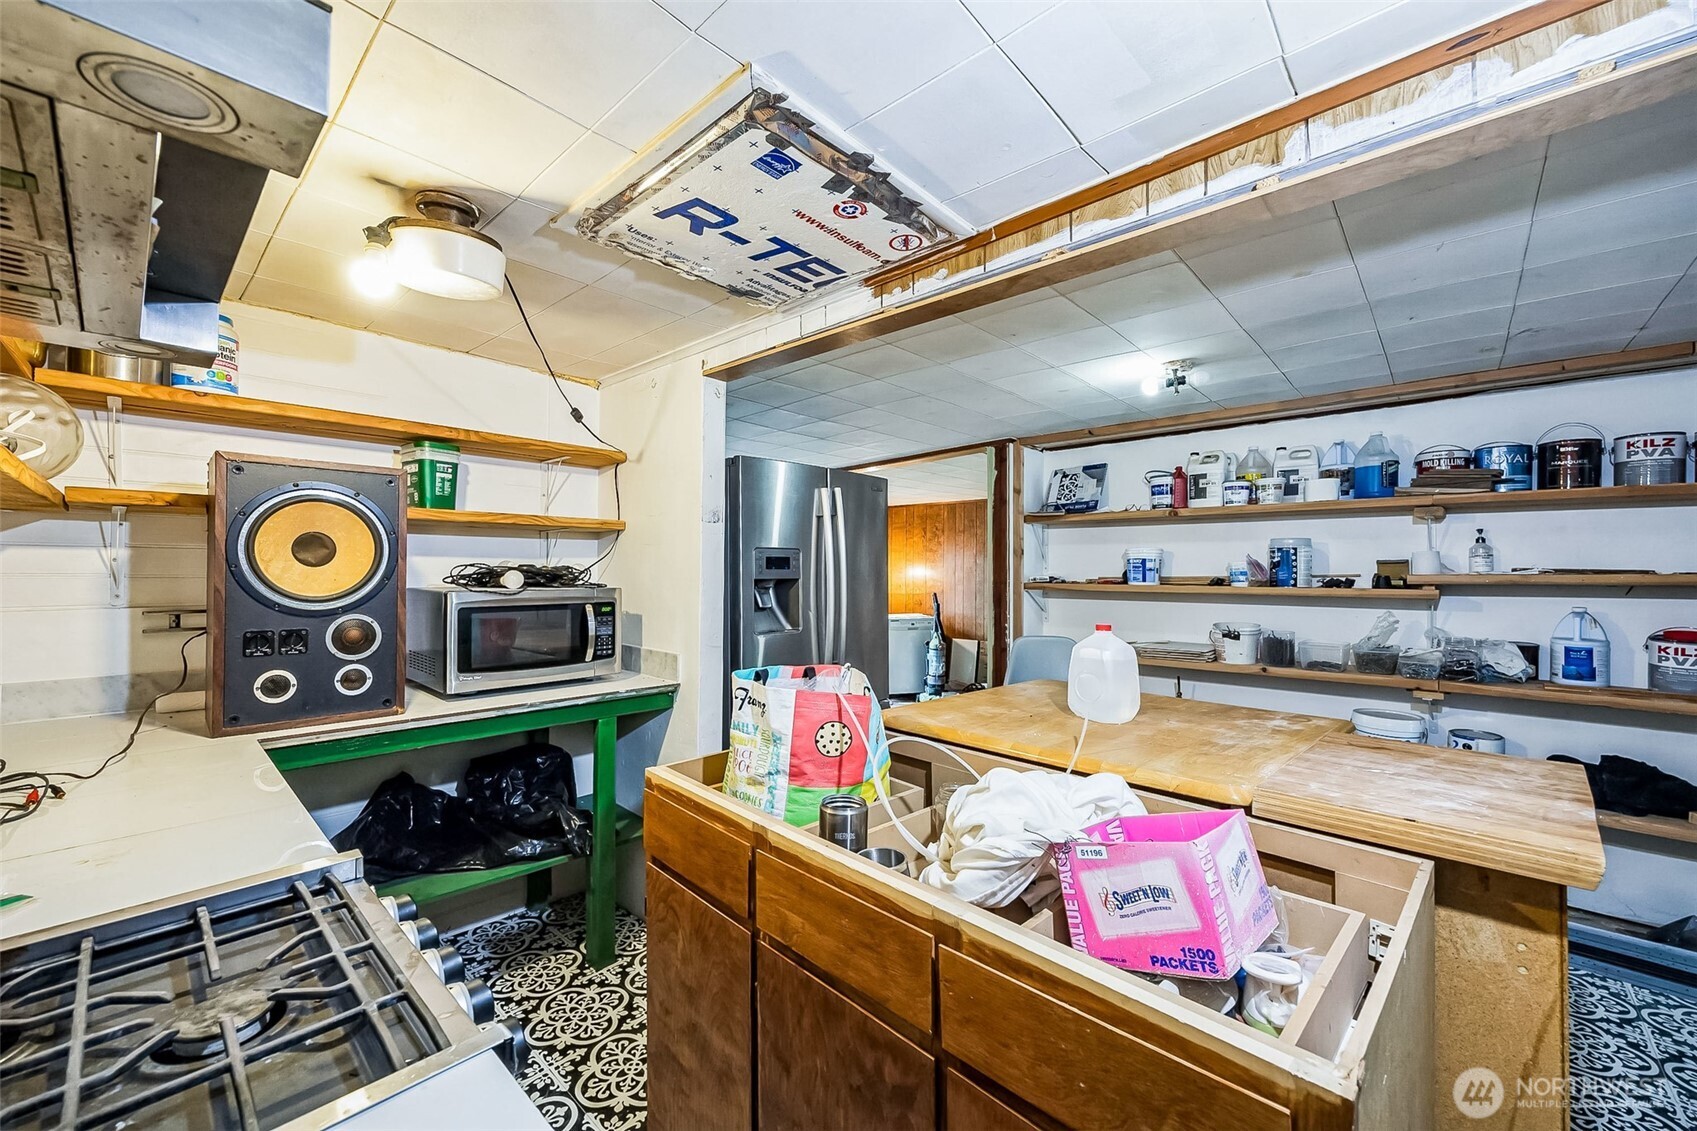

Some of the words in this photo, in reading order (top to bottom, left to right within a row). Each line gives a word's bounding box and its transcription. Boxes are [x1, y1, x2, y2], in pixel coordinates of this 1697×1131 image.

[627, 227, 657, 241] Uses:
[218, 344, 236, 355] anic
[216, 352, 236, 363] otein
[1626, 437, 1676, 450] KILZ
[1484, 453, 1529, 465] ROYAL
[1626, 447, 1676, 459] PVA
[1422, 460, 1439, 468] MOLD
[1440, 457, 1465, 467] KILLING
[1657, 645, 1697, 657] KIL
[734, 687, 767, 718] Franz
[730, 719, 759, 737] MILY
[1080, 849, 1103, 858] 51196
[1180, 946, 1216, 962] 1500
[1150, 955, 1219, 974] PACKETS
